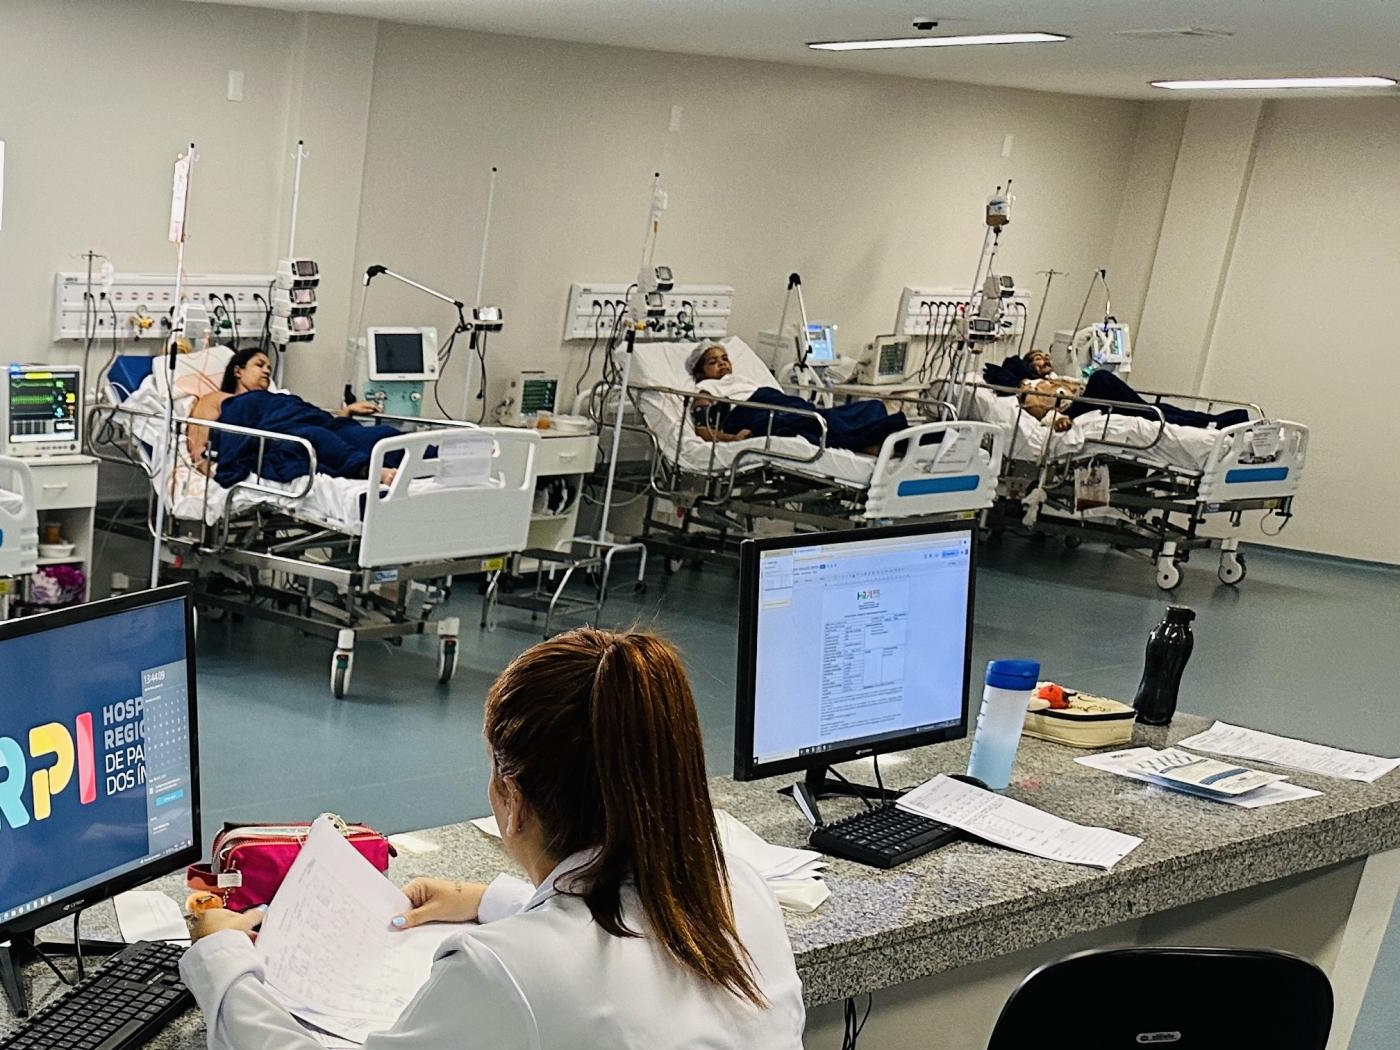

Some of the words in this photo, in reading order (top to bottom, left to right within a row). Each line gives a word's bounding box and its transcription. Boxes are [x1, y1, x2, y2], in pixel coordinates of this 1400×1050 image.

[103, 695, 144, 726] HOSP
[105, 750, 124, 773] DE
[127, 744, 145, 766] PA
[107, 769, 135, 795] DOS
